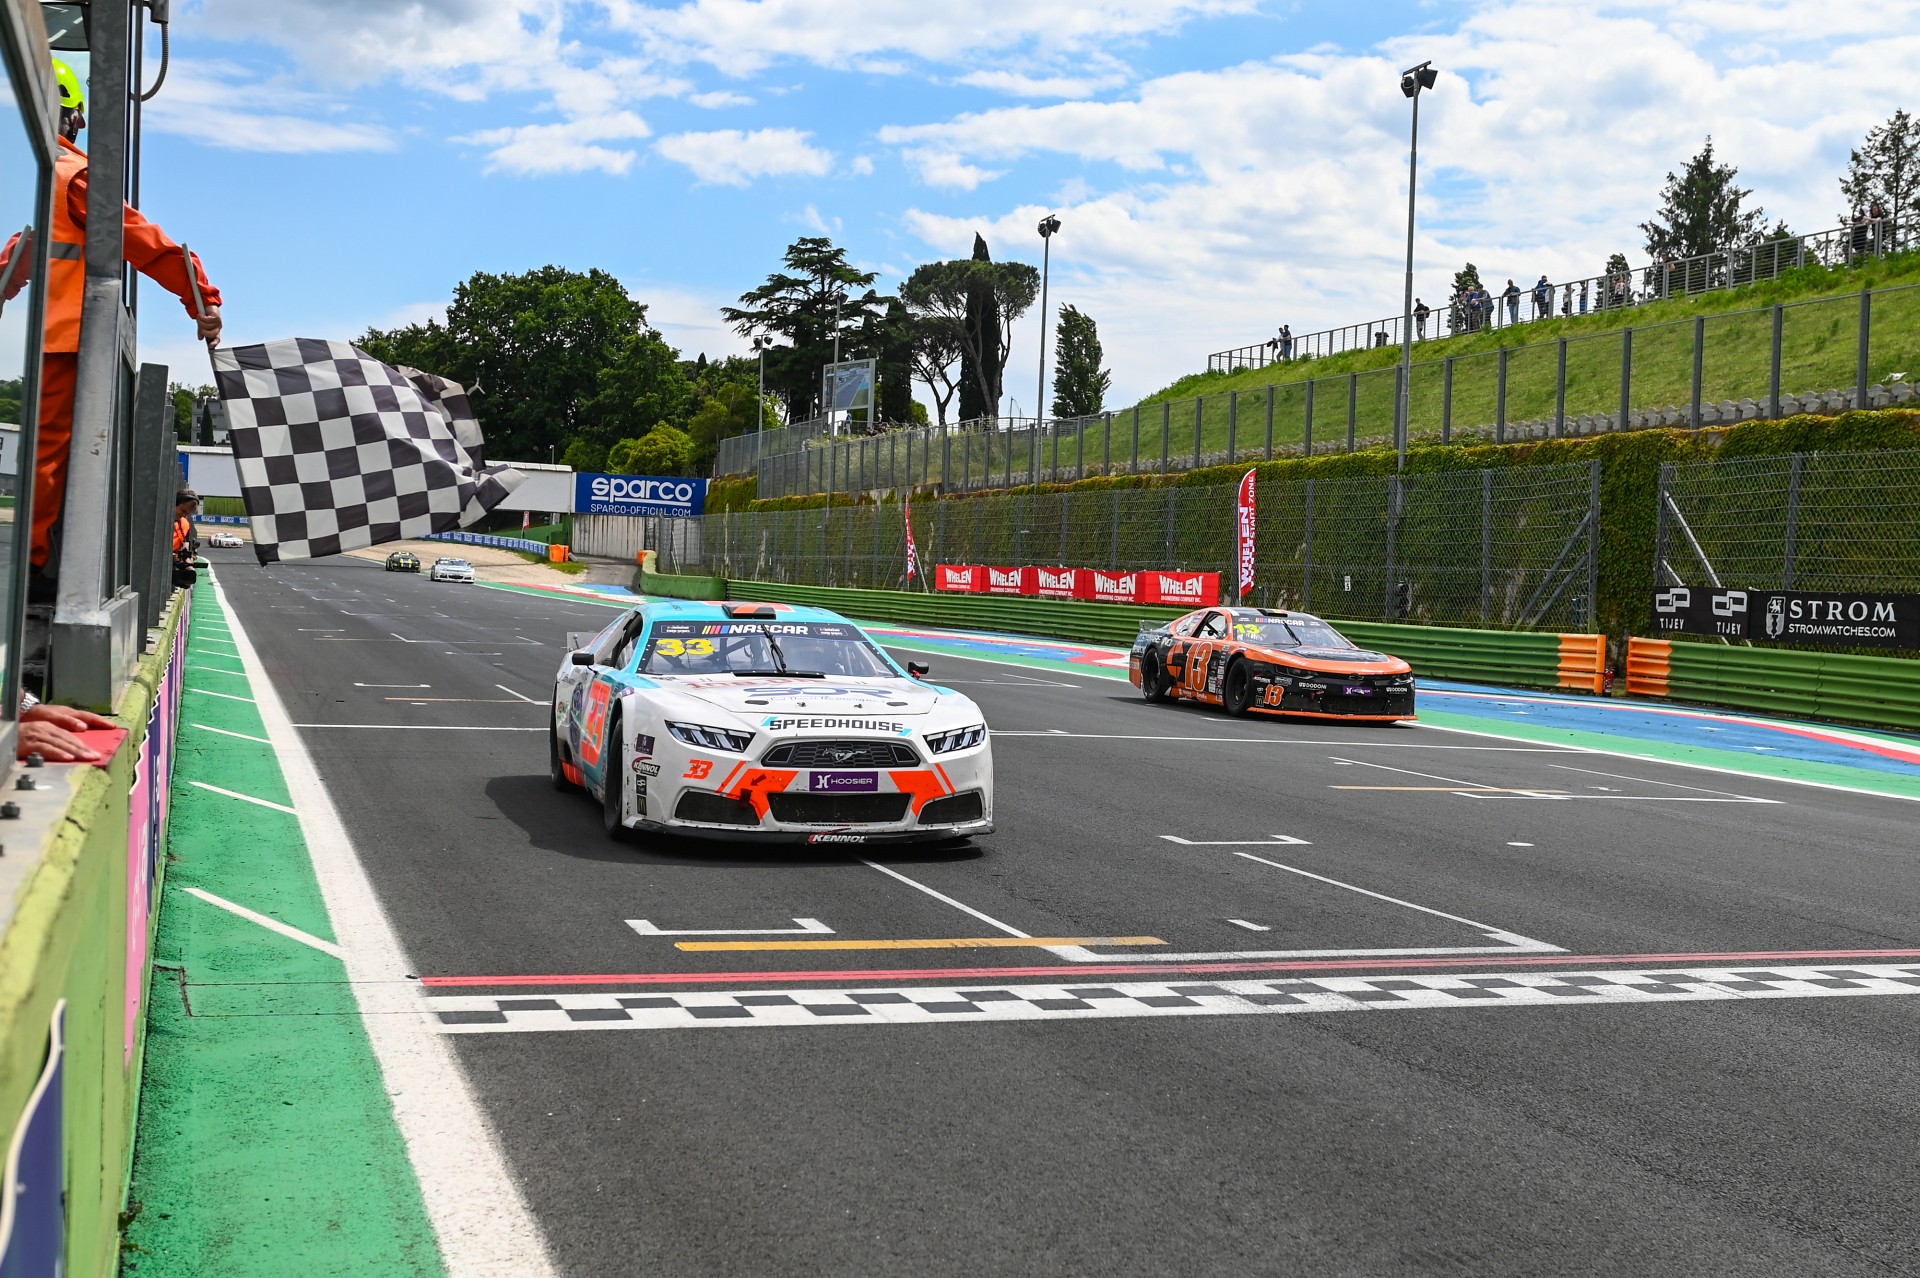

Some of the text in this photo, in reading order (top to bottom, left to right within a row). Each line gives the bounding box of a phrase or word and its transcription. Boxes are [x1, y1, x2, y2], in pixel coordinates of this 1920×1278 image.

[592, 477, 692, 502] sparco
[591, 504, 691, 517] SPARCO-OFFICIAL.COM
[1240, 507, 1250, 588] WHELEN
[946, 567, 972, 583] WHELEN
[989, 567, 1022, 586] WHELEN
[1038, 568, 1075, 589] WHELEN
[1094, 572, 1136, 594] WHELEN
[1160, 575, 1202, 595] WHELEN
[1789, 600, 1897, 622] STROM
[729, 624, 808, 635] NASCAR
[1234, 624, 1260, 634] 13
[1660, 618, 1684, 630] TIJEY
[1716, 622, 1741, 635] TIJEY
[1789, 624, 1896, 638] STROMWATCHES.COM
[656, 638, 716, 656] 33
[1185, 641, 1213, 692] 13
[1264, 684, 1284, 706] 13
[769, 718, 903, 732] SPEEDHOUSE
[633, 761, 659, 774] KENNOL
[682, 758, 714, 780] 33
[812, 834, 865, 843] KENNOL
